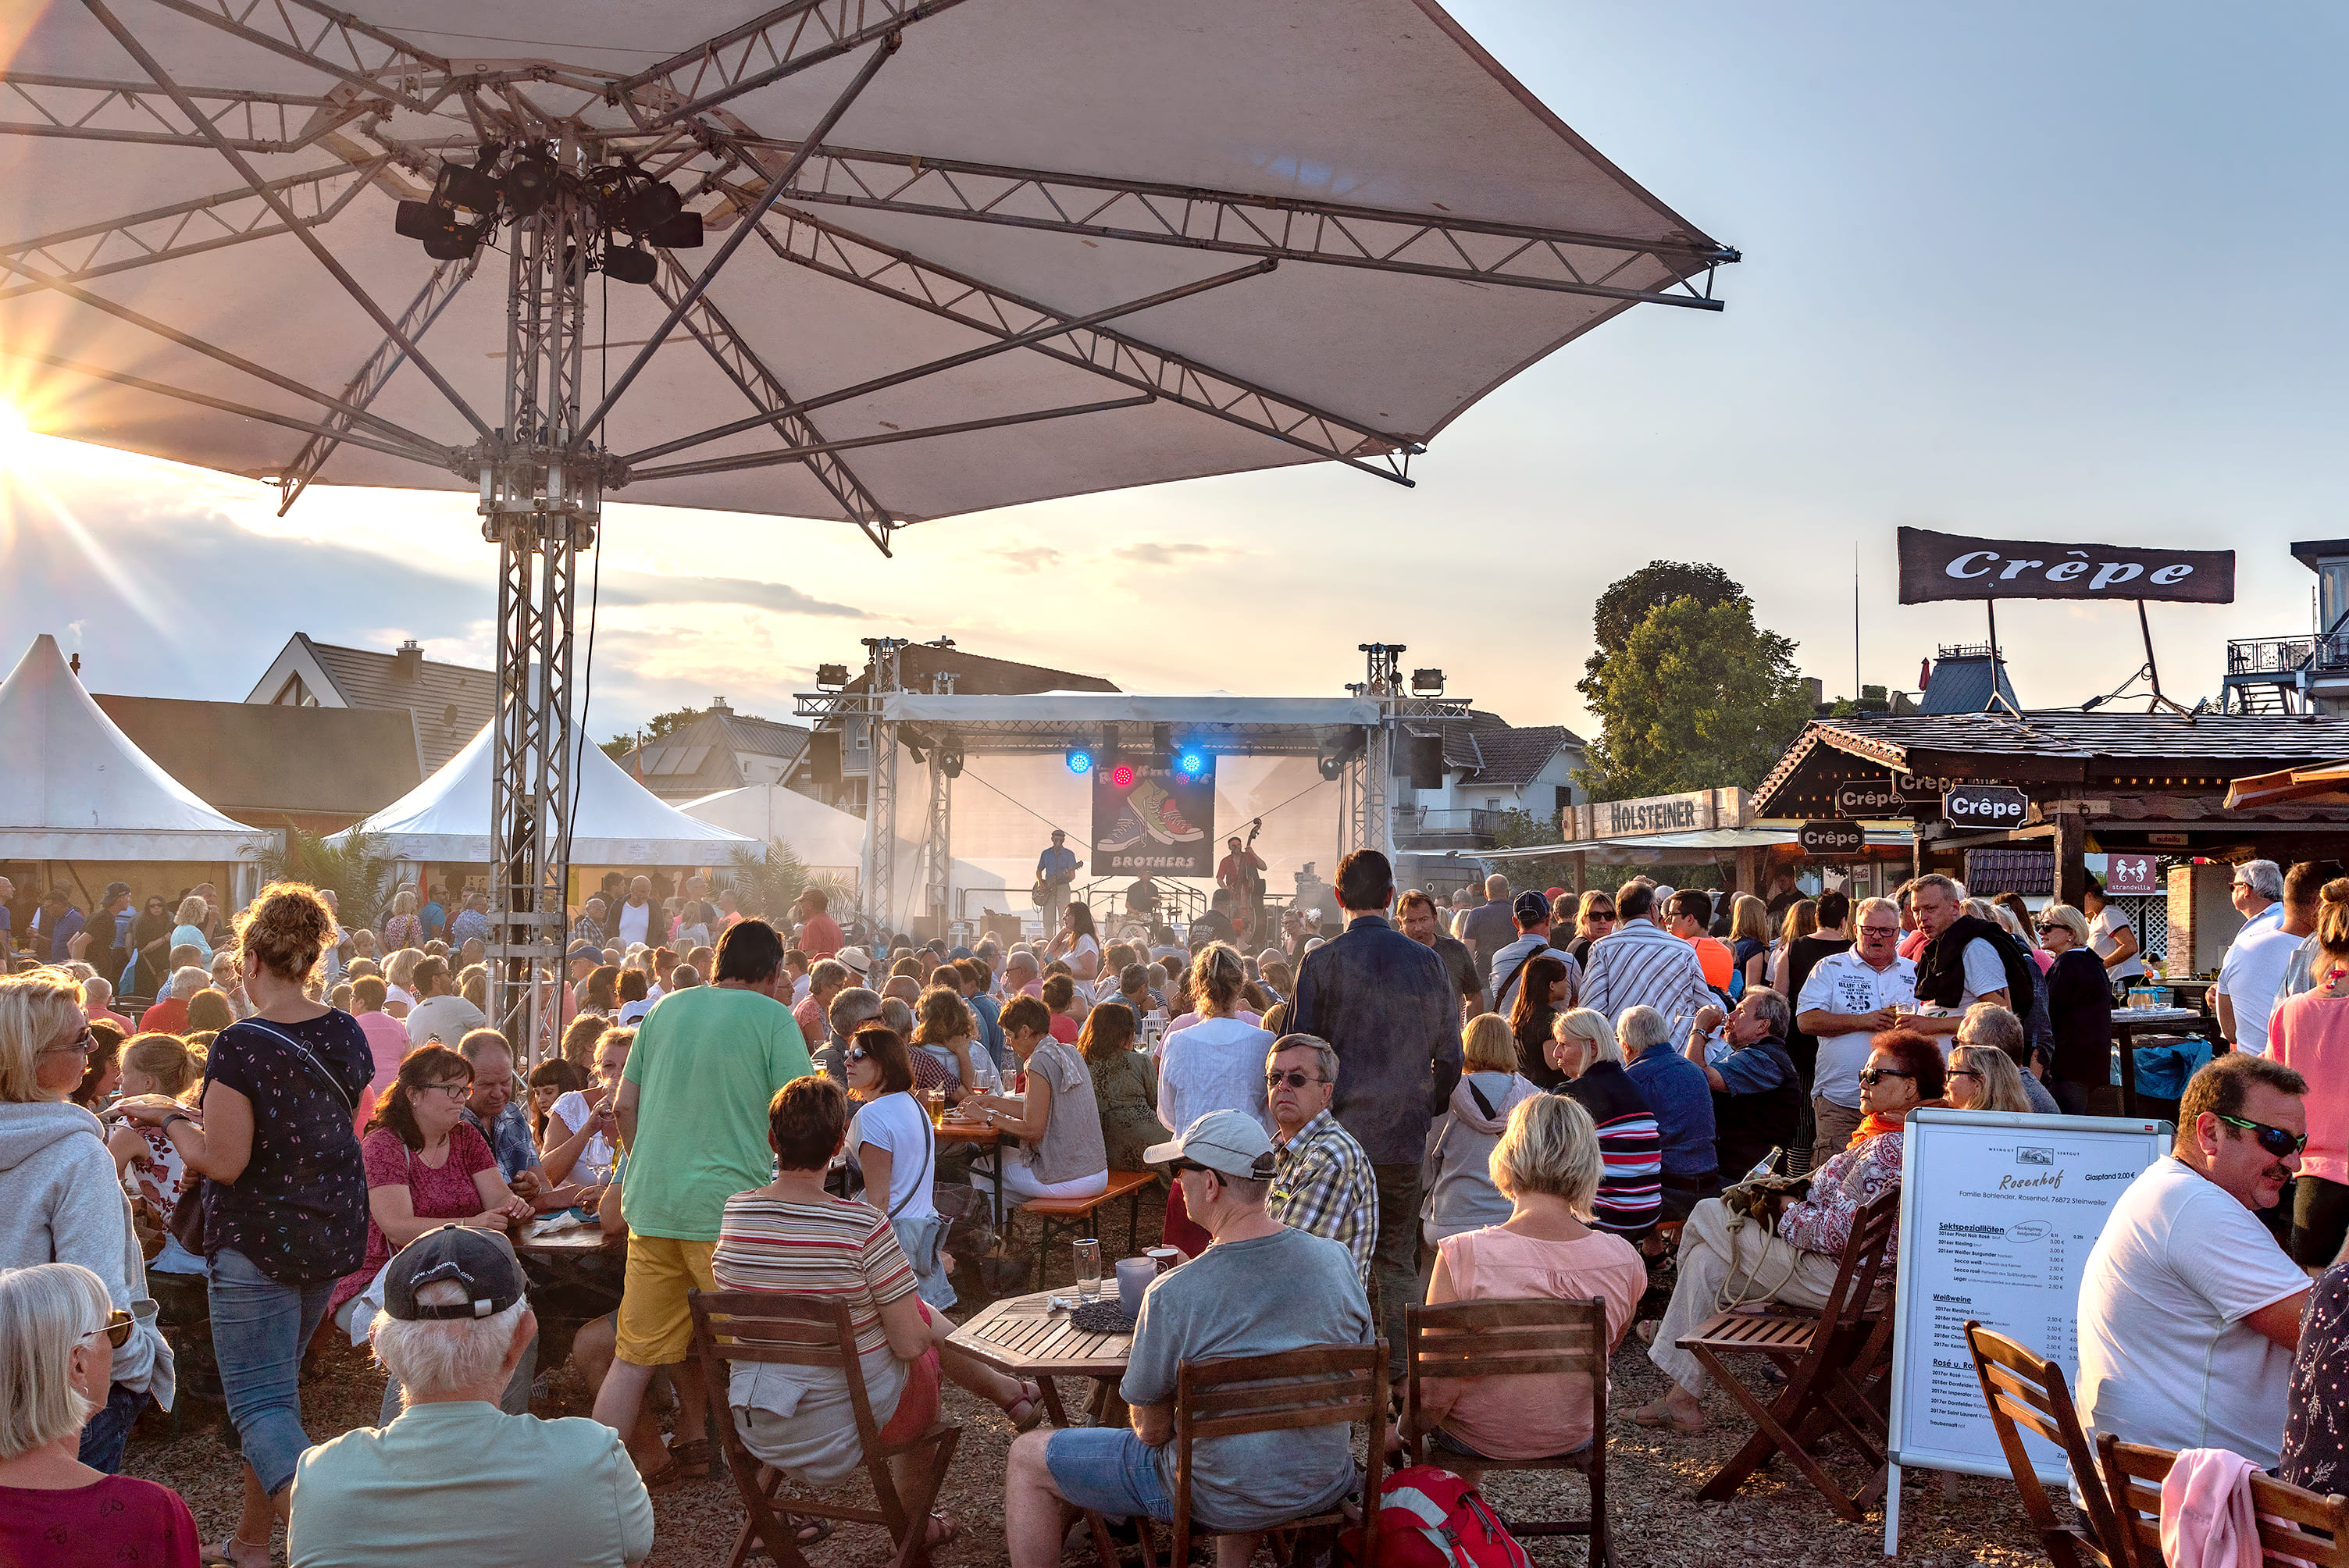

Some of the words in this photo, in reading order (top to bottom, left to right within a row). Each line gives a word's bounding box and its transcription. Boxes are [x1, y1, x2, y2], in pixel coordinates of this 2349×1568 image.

[1945, 551, 2193, 589] Crêpe
[1842, 791, 1900, 807] Crêpe
[1952, 798, 2022, 818] Crêpe
[1611, 800, 1695, 833] HOLSTEINER
[1804, 831, 1859, 846] Crêpe
[1112, 856, 1195, 868] BROTHERS
[1999, 1169, 2064, 1190] Rosenhof
[2072, 1198, 2108, 1206] Steinweiler
[1939, 1222, 2004, 1233] Sektspezialitäten
[1933, 1294, 1971, 1303] Weißweine
[1933, 1358, 1951, 1367] Rosé
